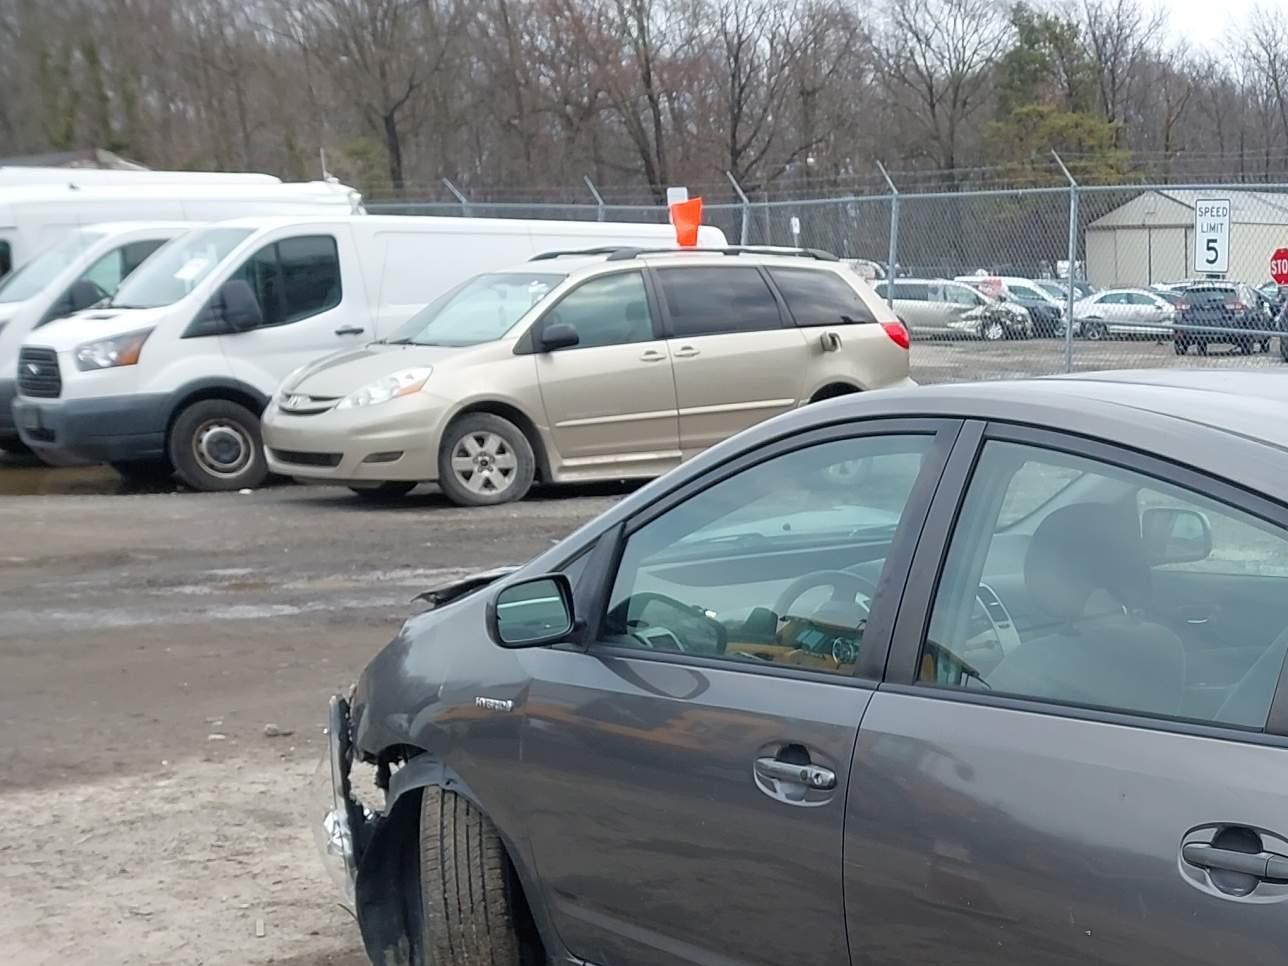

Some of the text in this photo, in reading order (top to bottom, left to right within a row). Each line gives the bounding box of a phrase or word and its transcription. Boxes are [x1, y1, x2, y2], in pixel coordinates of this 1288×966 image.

[1198, 206, 1228, 217] SPEED
[1200, 223, 1224, 233] LIMIT
[1205, 239, 1219, 264] 5
